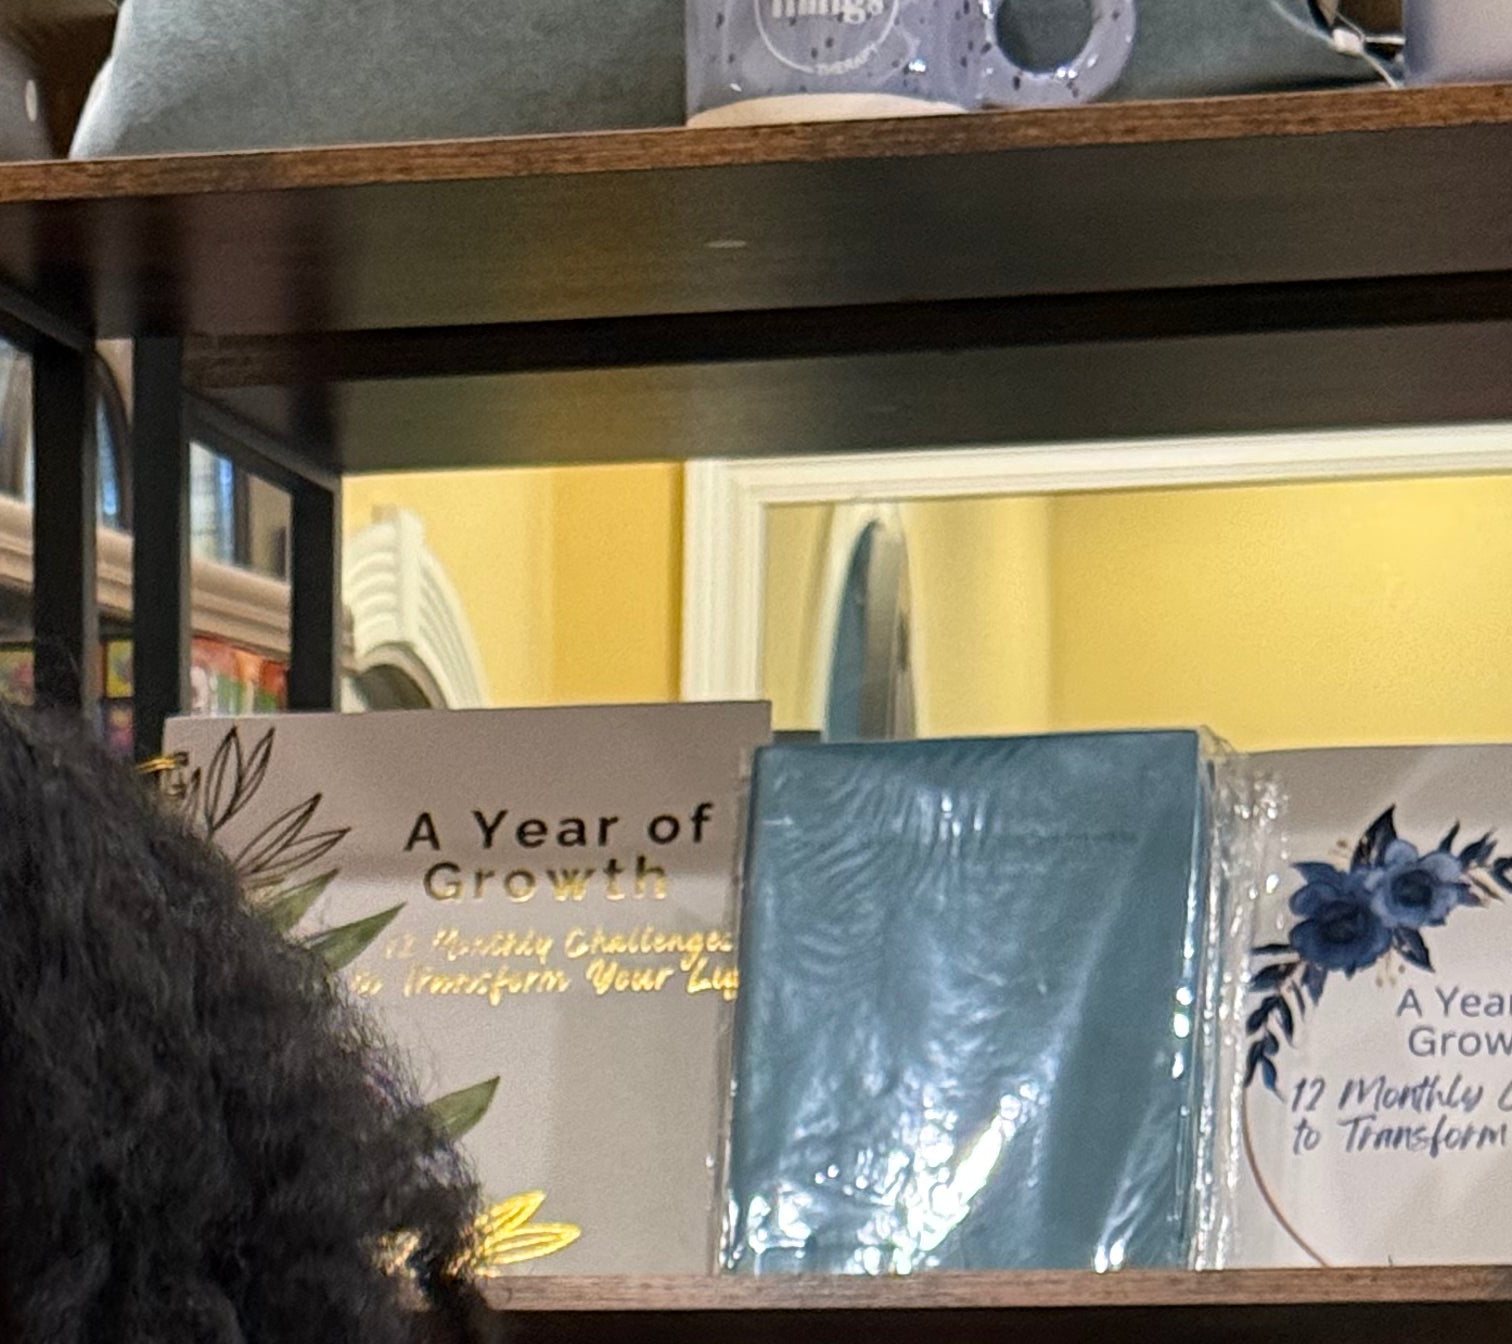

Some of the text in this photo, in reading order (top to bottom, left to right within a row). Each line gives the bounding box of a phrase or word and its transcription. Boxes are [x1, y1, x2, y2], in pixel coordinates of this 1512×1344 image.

[403, 802, 714, 852] A Year of
[422, 855, 669, 902] Growth
[431, 927, 554, 967] Monthly
[564, 925, 734, 972] Challenges
[403, 961, 571, 1007] Transform
[586, 957, 675, 996] Your
[1396, 988, 1424, 1019] A
[1291, 1076, 1326, 1113] 12
[1338, 1073, 1485, 1113] Monthly
[1292, 1113, 1507, 1159] to Transform
